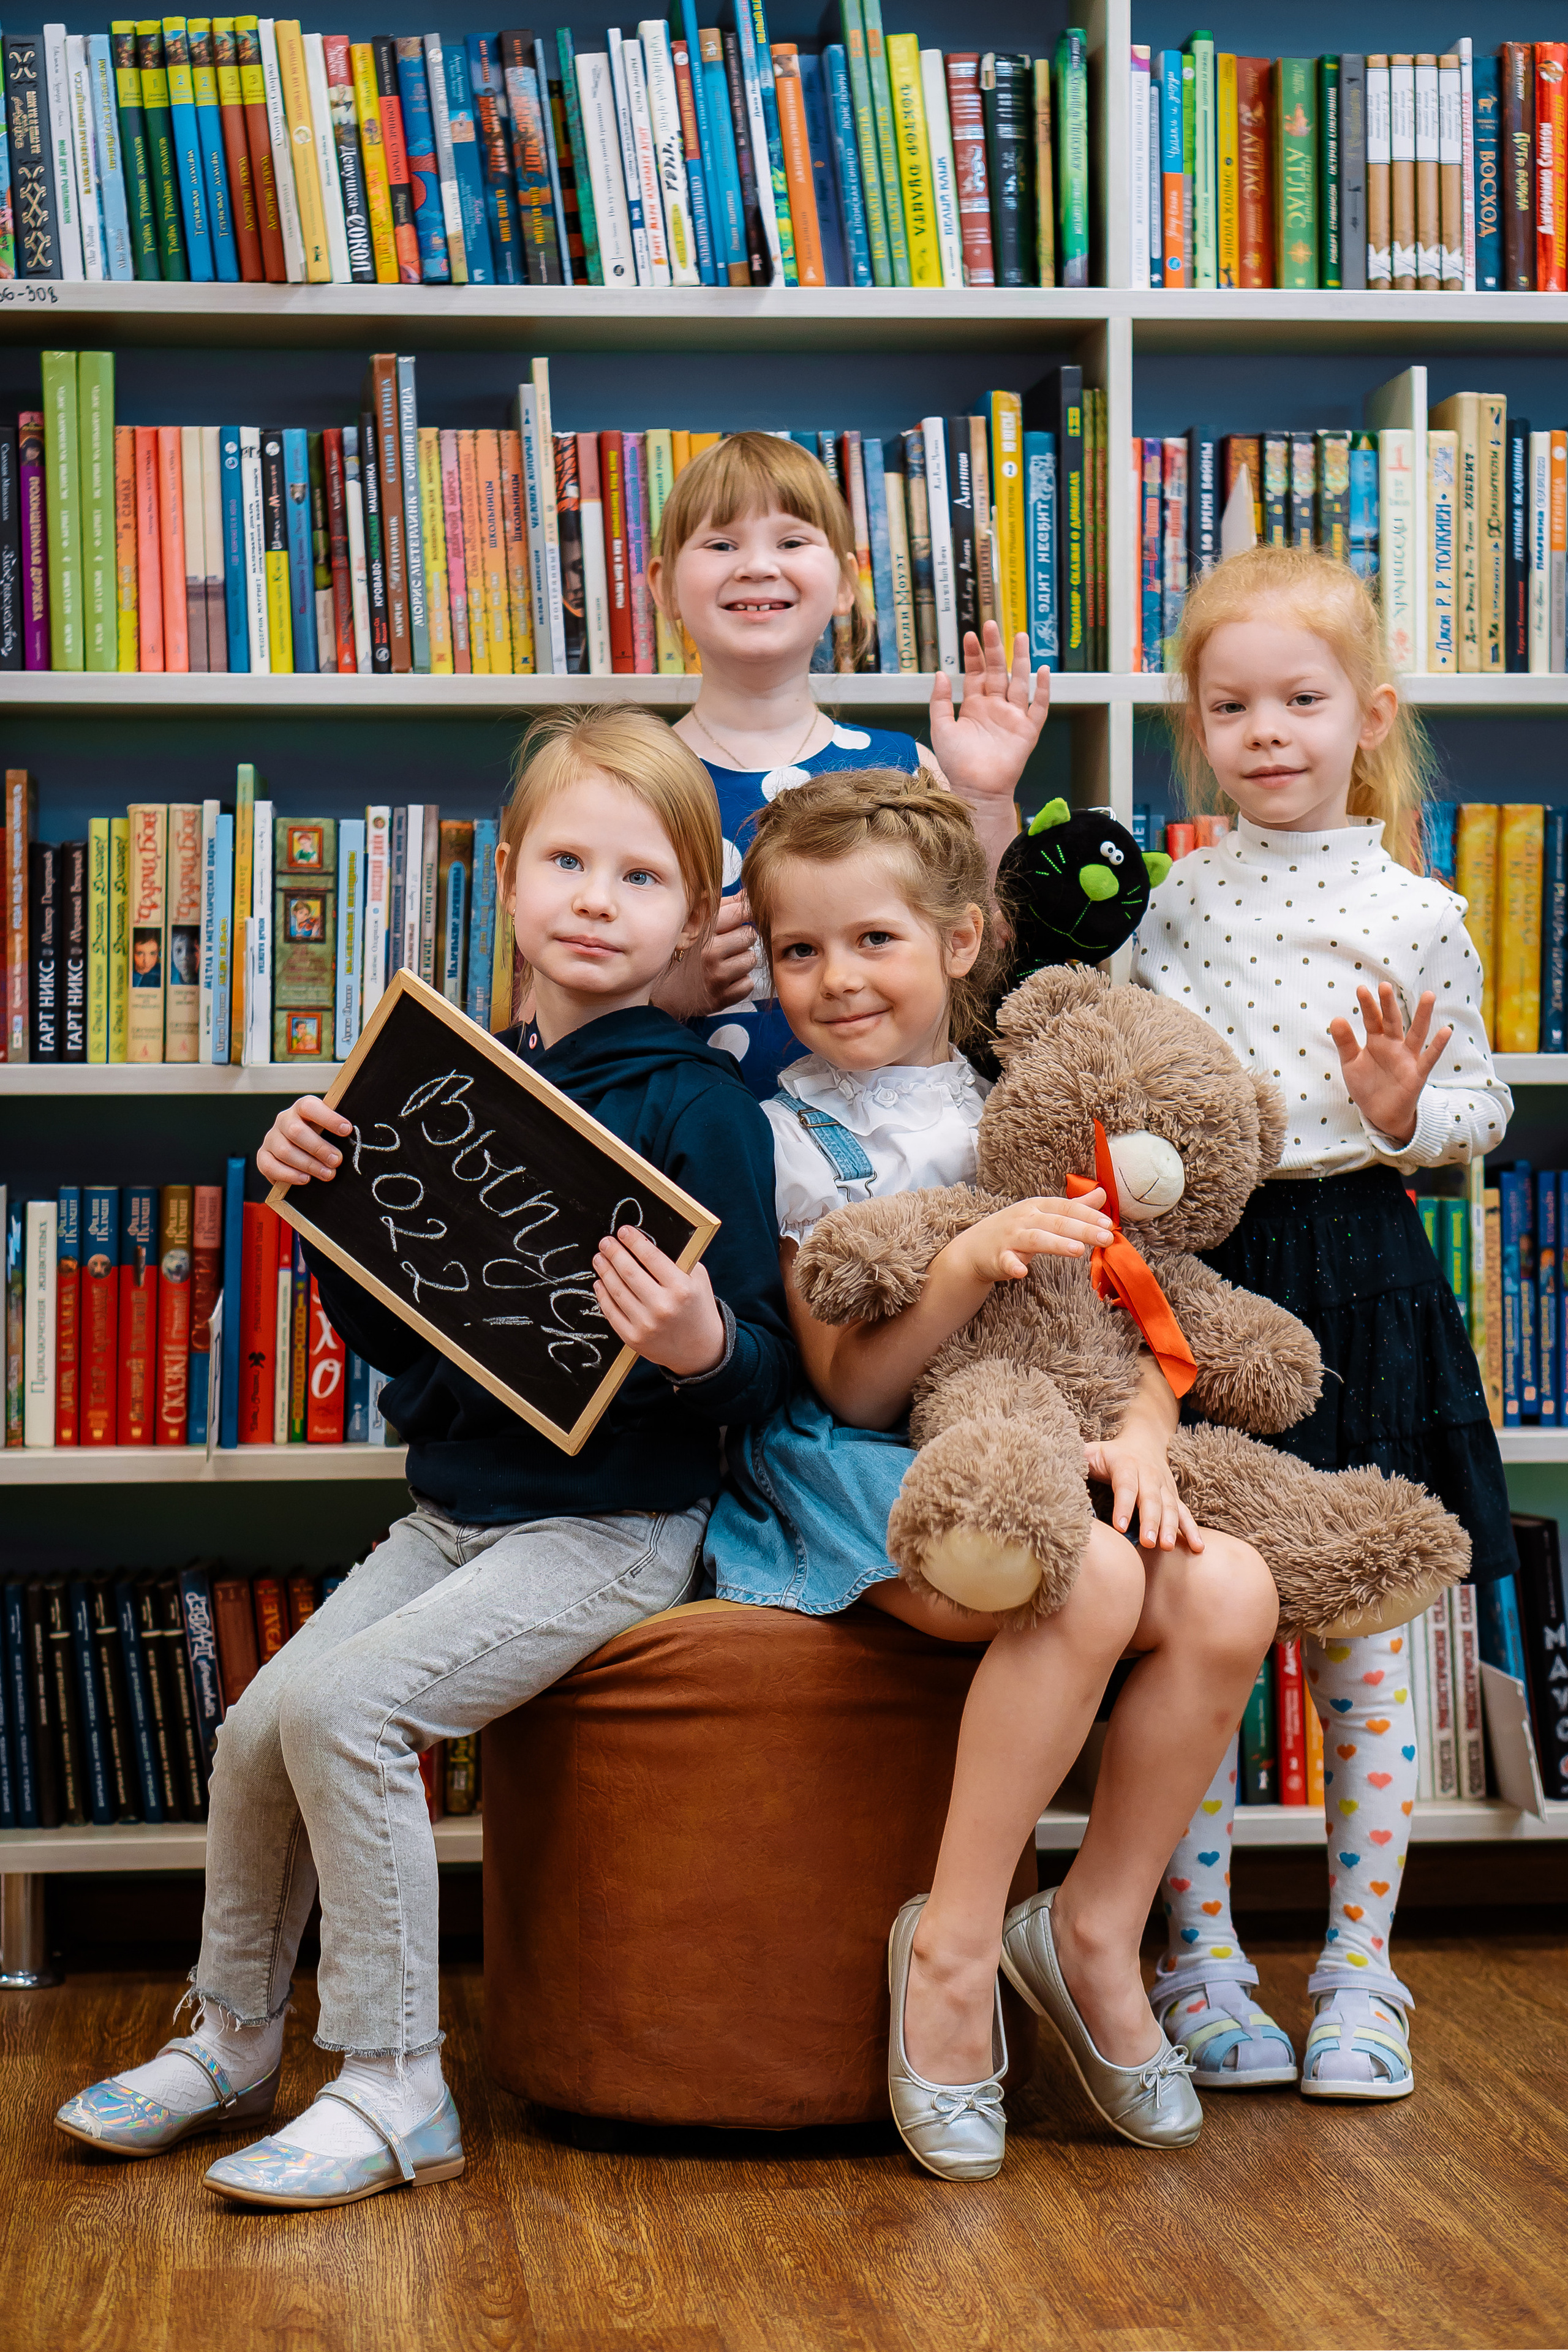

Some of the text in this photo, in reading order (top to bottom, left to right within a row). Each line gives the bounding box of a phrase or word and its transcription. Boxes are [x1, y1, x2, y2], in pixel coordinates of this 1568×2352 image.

[900, 84, 919, 156] ДОКТОР
[937, 157, 954, 236] БЕЛЫЙ КЛЫК
[1242, 130, 1262, 201] АТЛАС
[1286, 146, 1306, 228] АТЛАС
[1478, 150, 1498, 238] ВОСХОД
[873, 240, 886, 258] НА
[893, 240, 905, 258] НА
[366, 463, 384, 607] КРОВАВО-КРАСНАЯ МАШИНКА
[402, 386, 424, 628] МОРИС МЕТЕРЛИНК СИНЯЯ ПТИЦА
[484, 480, 498, 549] ШКОЛЬНИЦЫ
[511, 473, 523, 542] ШКОЛЬНИЦЫ
[1200, 442, 1213, 550] ВО ВРЕМЯ ВОЙНЫ
[28, 476, 44, 622] ПОХИЩЕННАЯ ДРУЖБА
[1036, 501, 1051, 612] ЭДИТ НЕСБИТ
[1434, 503, 1453, 653] Джон Р. Р. ТОЛКИЕН
[39, 960, 55, 1052] ГАРТ НИКС
[67, 959, 83, 1050] ГАРТ НИКС
[399, 1069, 609, 1374] Выпуск
[161, 1344, 187, 1423] СКАЗКИ
[310, 1291, 343, 1398] ХО
